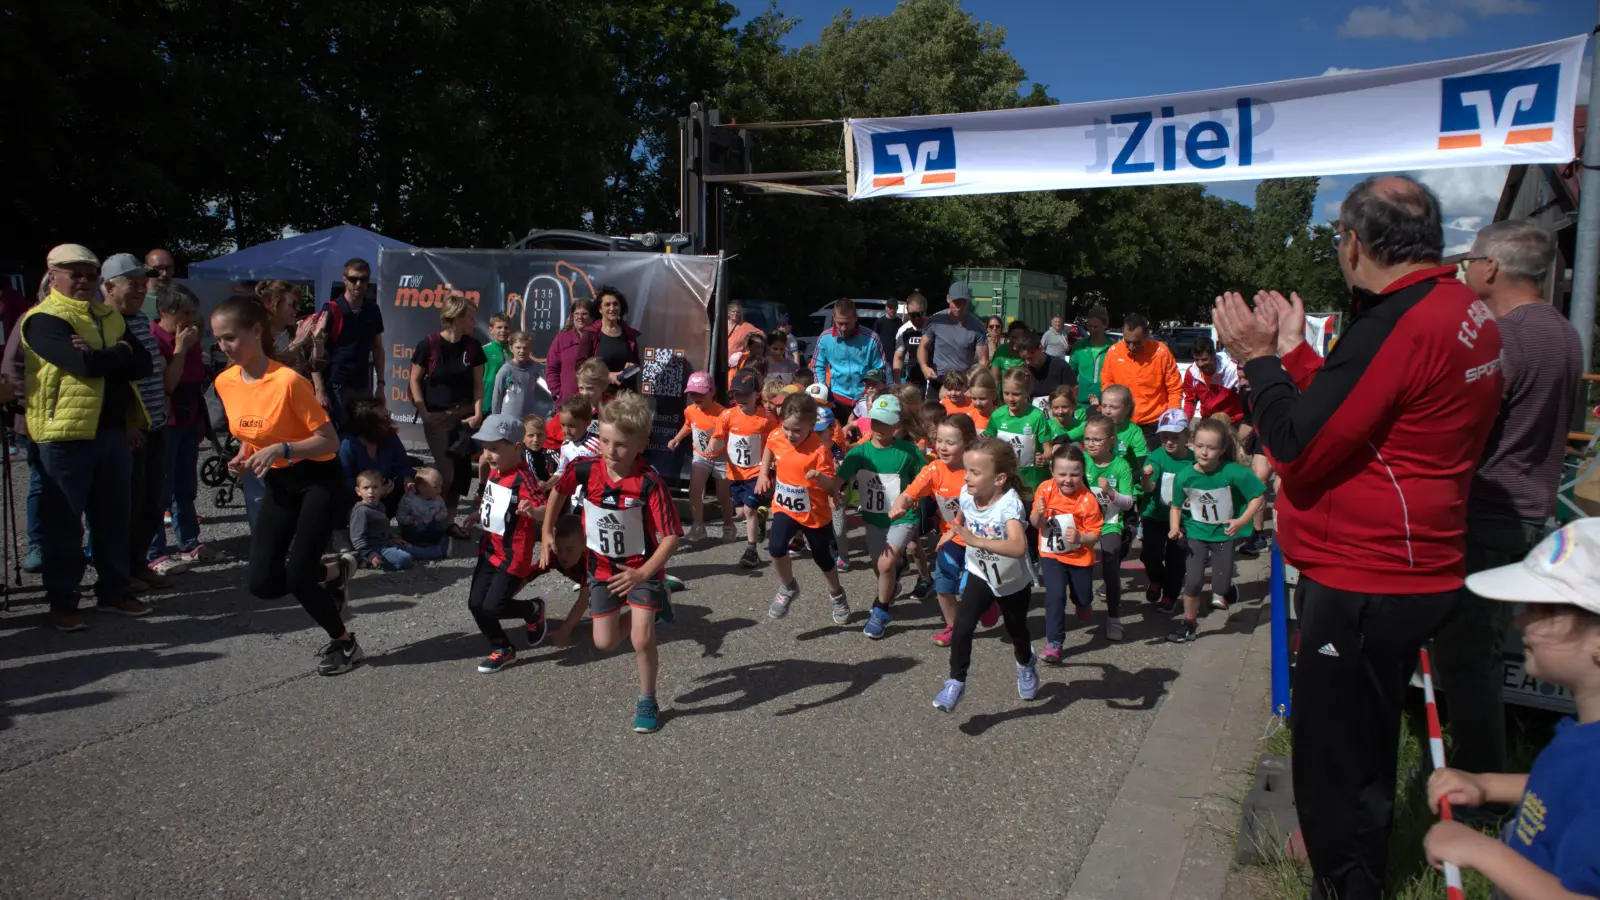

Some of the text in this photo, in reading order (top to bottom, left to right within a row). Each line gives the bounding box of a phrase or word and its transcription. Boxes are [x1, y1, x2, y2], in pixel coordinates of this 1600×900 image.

[1110, 97, 1252, 174] Ziel
[398, 274, 424, 288] ITW
[1457, 321, 1479, 350] FC
[736, 448, 751, 466] 25
[776, 493, 805, 512] 446
[866, 488, 885, 511] 38
[1202, 503, 1219, 521] 41
[596, 520, 625, 531] adidas
[598, 528, 625, 555] 58
[1046, 531, 1066, 552] 45
